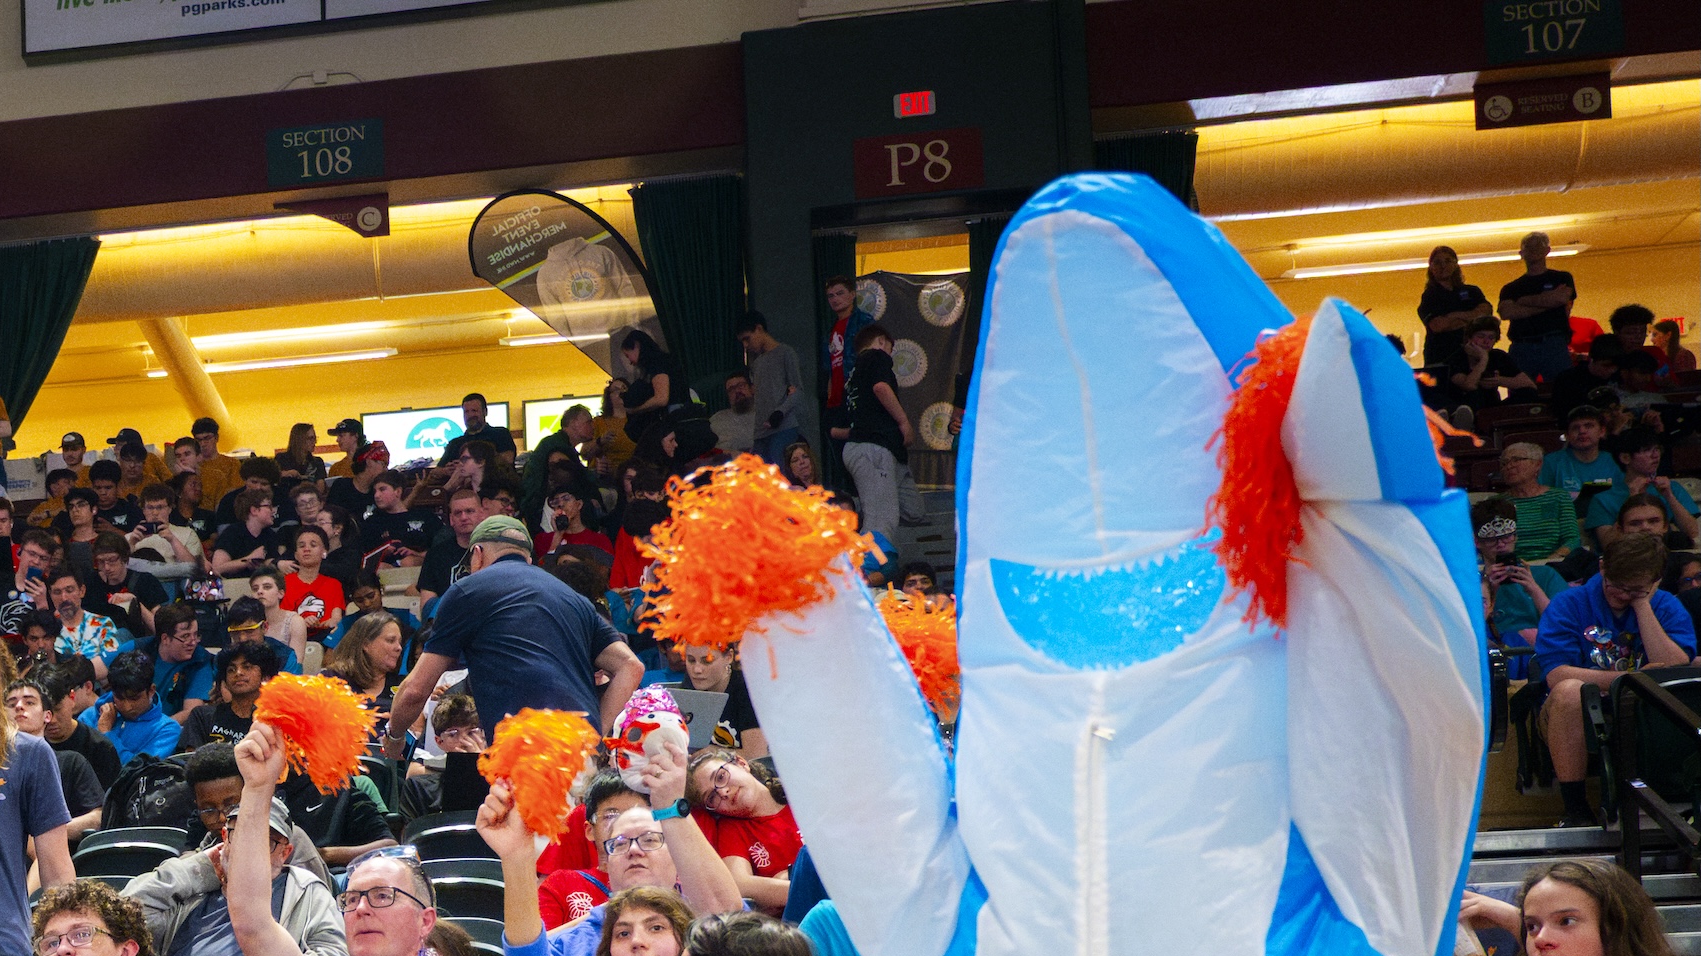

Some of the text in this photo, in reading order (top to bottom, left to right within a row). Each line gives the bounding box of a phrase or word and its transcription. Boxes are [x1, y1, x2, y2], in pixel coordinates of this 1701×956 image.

[1503, 0, 1600, 22] SECTION
[1522, 18, 1587, 54] 107
[900, 91, 931, 116] EXIT
[1581, 92, 1594, 109] B
[283, 125, 366, 149] SECTION
[298, 146, 353, 178] 108
[884, 139, 952, 187] P8
[361, 211, 375, 226] C
